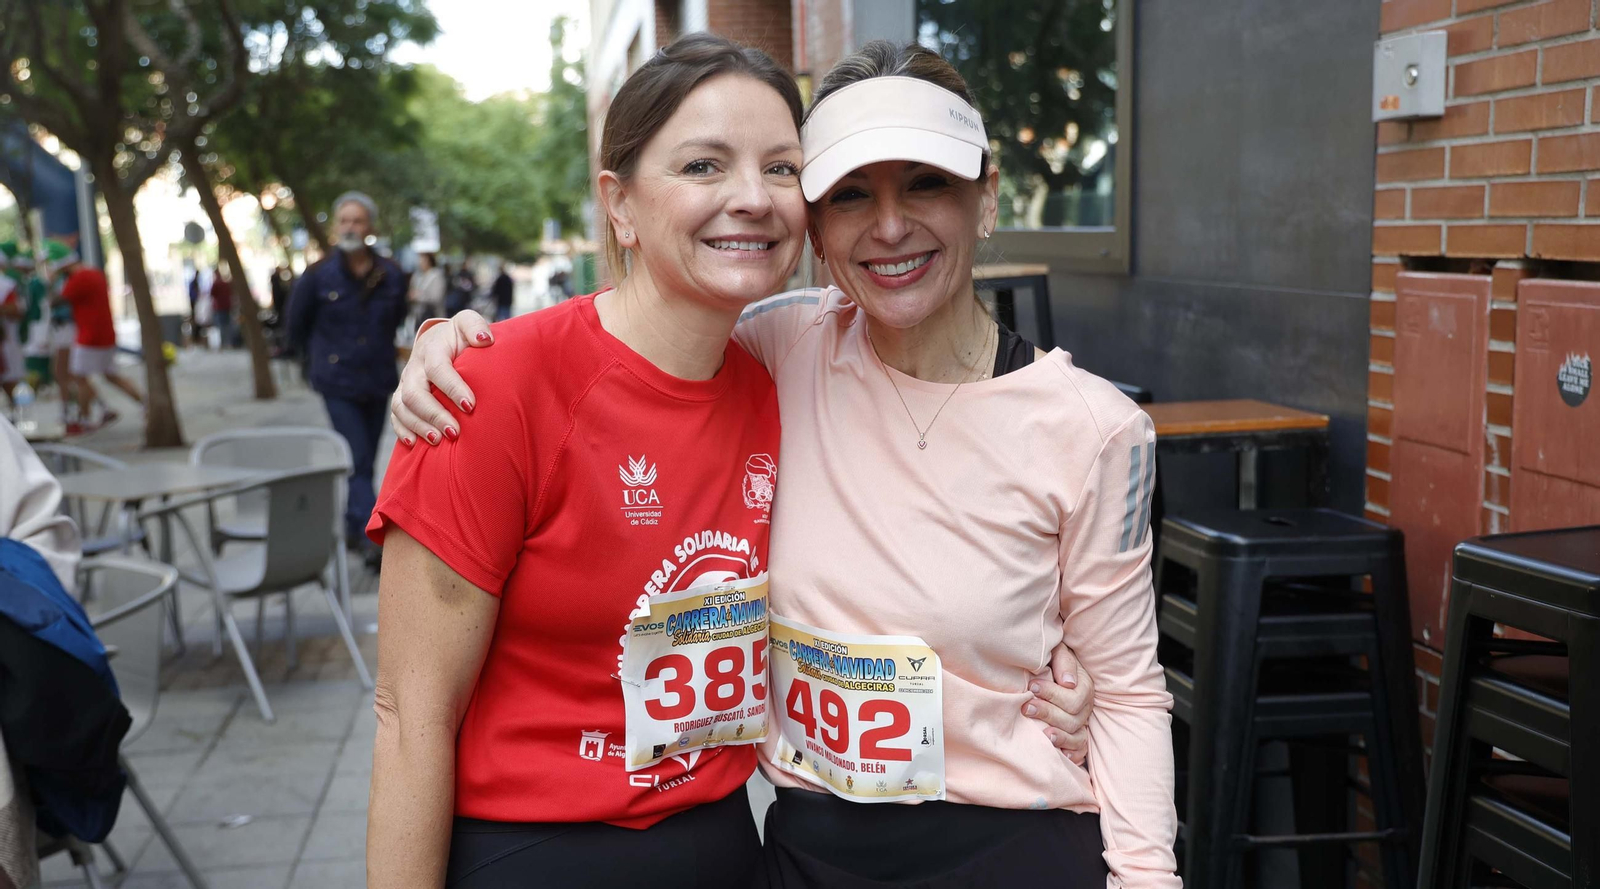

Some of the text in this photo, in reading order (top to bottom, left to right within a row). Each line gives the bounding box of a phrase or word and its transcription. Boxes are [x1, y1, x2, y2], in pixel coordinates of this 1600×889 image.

[949, 108, 979, 132] KIPRUN
[622, 489, 660, 505] UCA
[625, 510, 662, 518] Universidad
[640, 518, 659, 526] Cádiz
[674, 530, 750, 564] SOLIDARIA
[704, 591, 746, 606] XI EDICIÓN
[633, 622, 665, 632] EVOS
[666, 606, 727, 637] CARRERA
[672, 629, 712, 648] Solidaria
[712, 632, 734, 641] CIUDAD
[734, 630, 742, 638] DE
[820, 641, 848, 655] EDICIÓN
[789, 639, 832, 673] CARRERA
[833, 654, 897, 682] NAVIDAD
[644, 635, 768, 721] 385
[844, 680, 896, 693] ALGECIRAS
[674, 717, 713, 734] RODRIGUEZ
[713, 710, 746, 725] BUSCATÓ,
[786, 677, 913, 762] 492
[615, 750, 626, 759] Alg
[805, 739, 824, 757] VIVANCO
[860, 761, 886, 774] BELÉN
[657, 774, 696, 793] TURIAL
